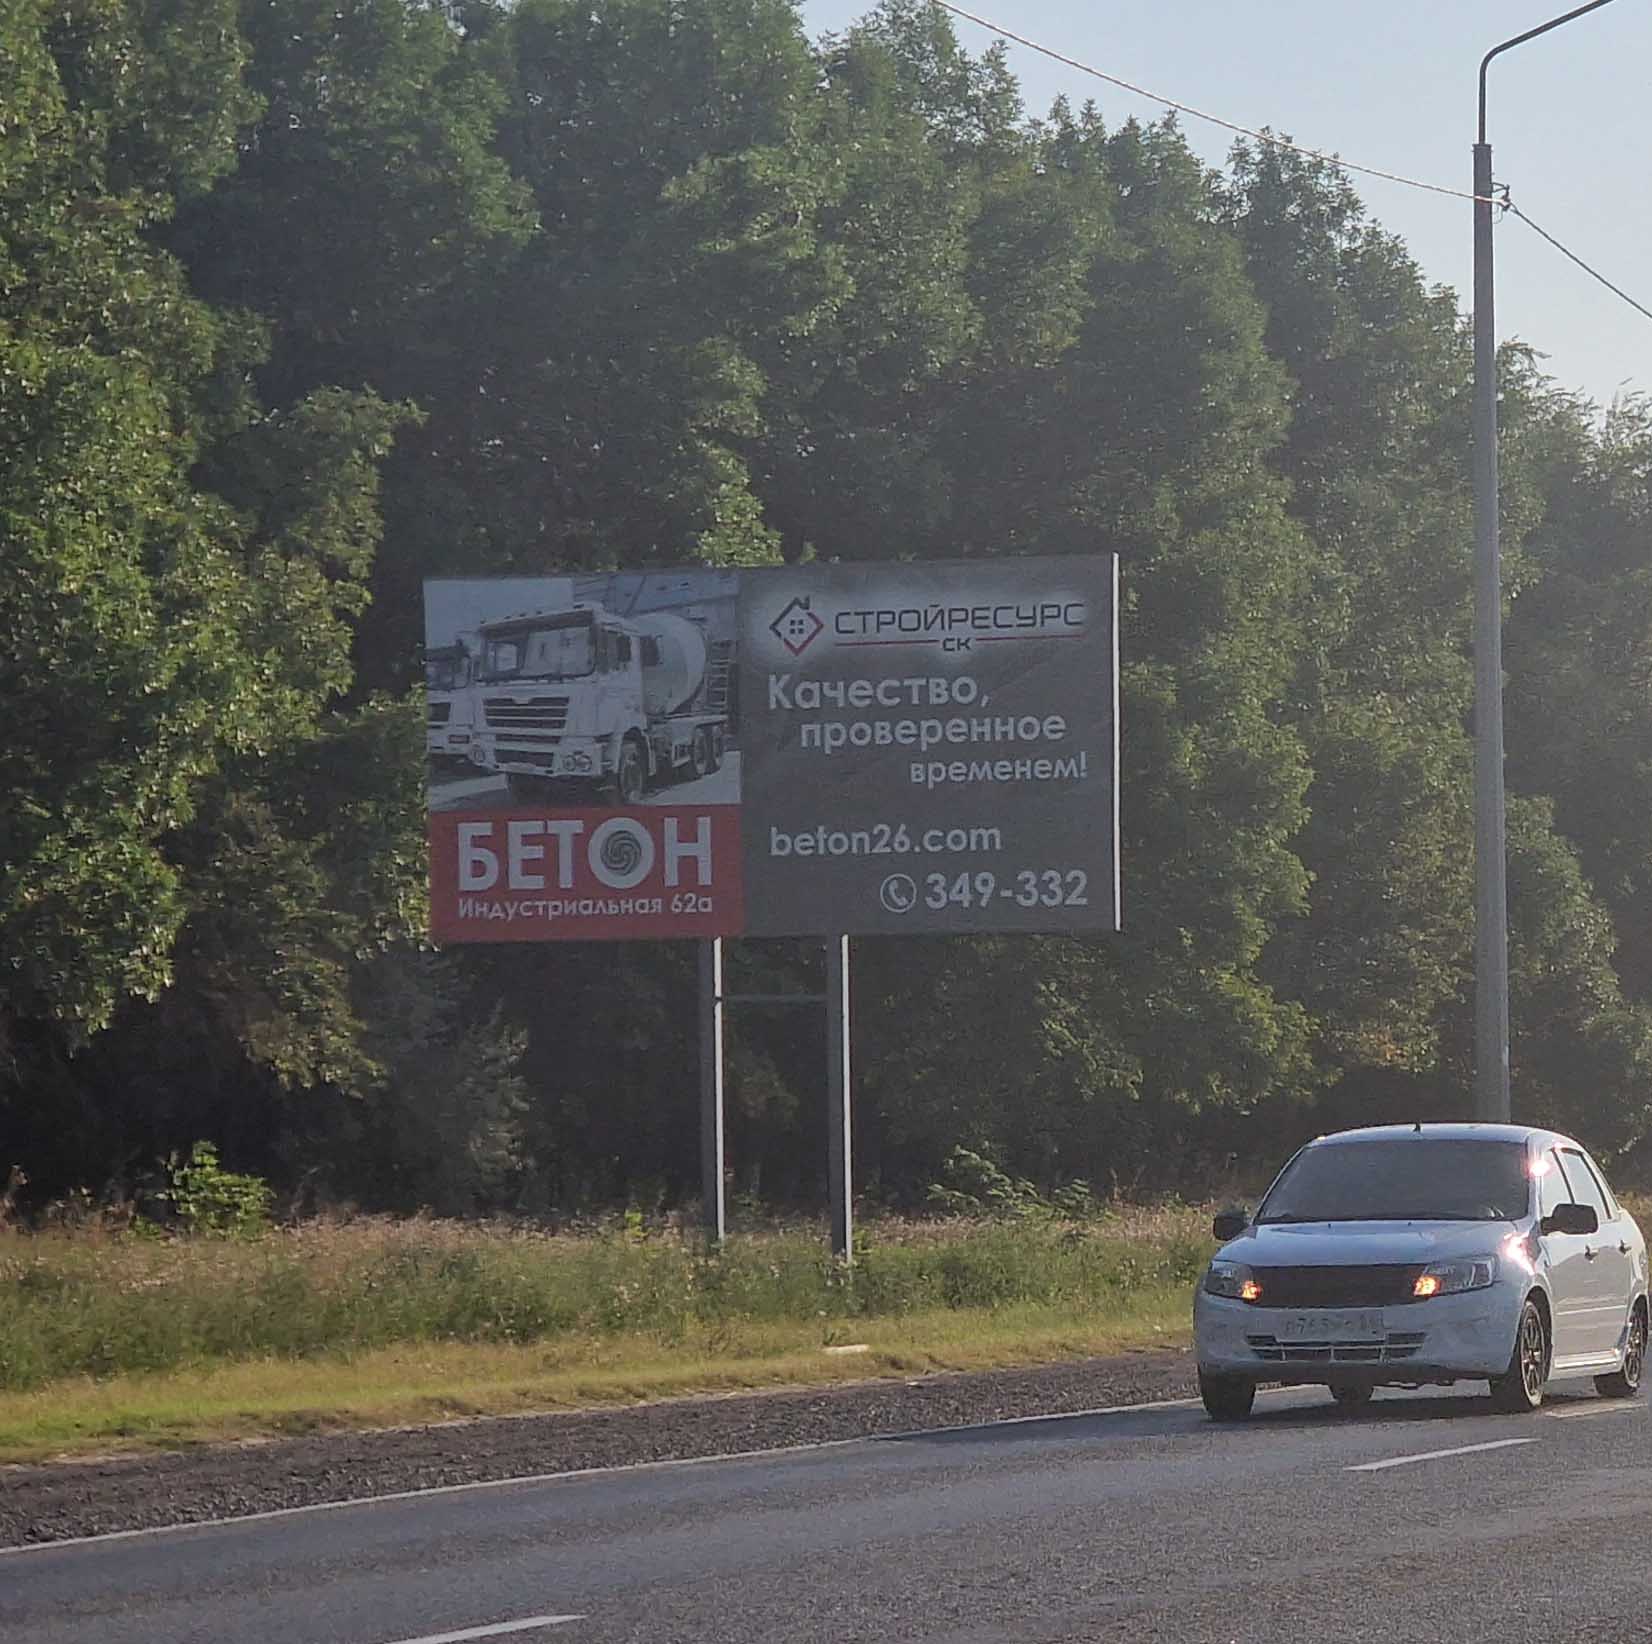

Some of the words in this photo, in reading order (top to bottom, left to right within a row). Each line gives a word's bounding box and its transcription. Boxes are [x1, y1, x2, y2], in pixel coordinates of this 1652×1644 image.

[834, 603, 1085, 635] СТРОЙРЕСУРС
[942, 636, 972, 651] СК
[768, 673, 989, 709] Качество,
[800, 714, 1067, 754] проверенное
[910, 751, 1088, 788] временем!
[457, 816, 713, 891] БЕТОН
[770, 823, 1001, 856] beton26.com
[925, 869, 1088, 909] 349-332
[458, 898, 662, 921] Индустриальная
